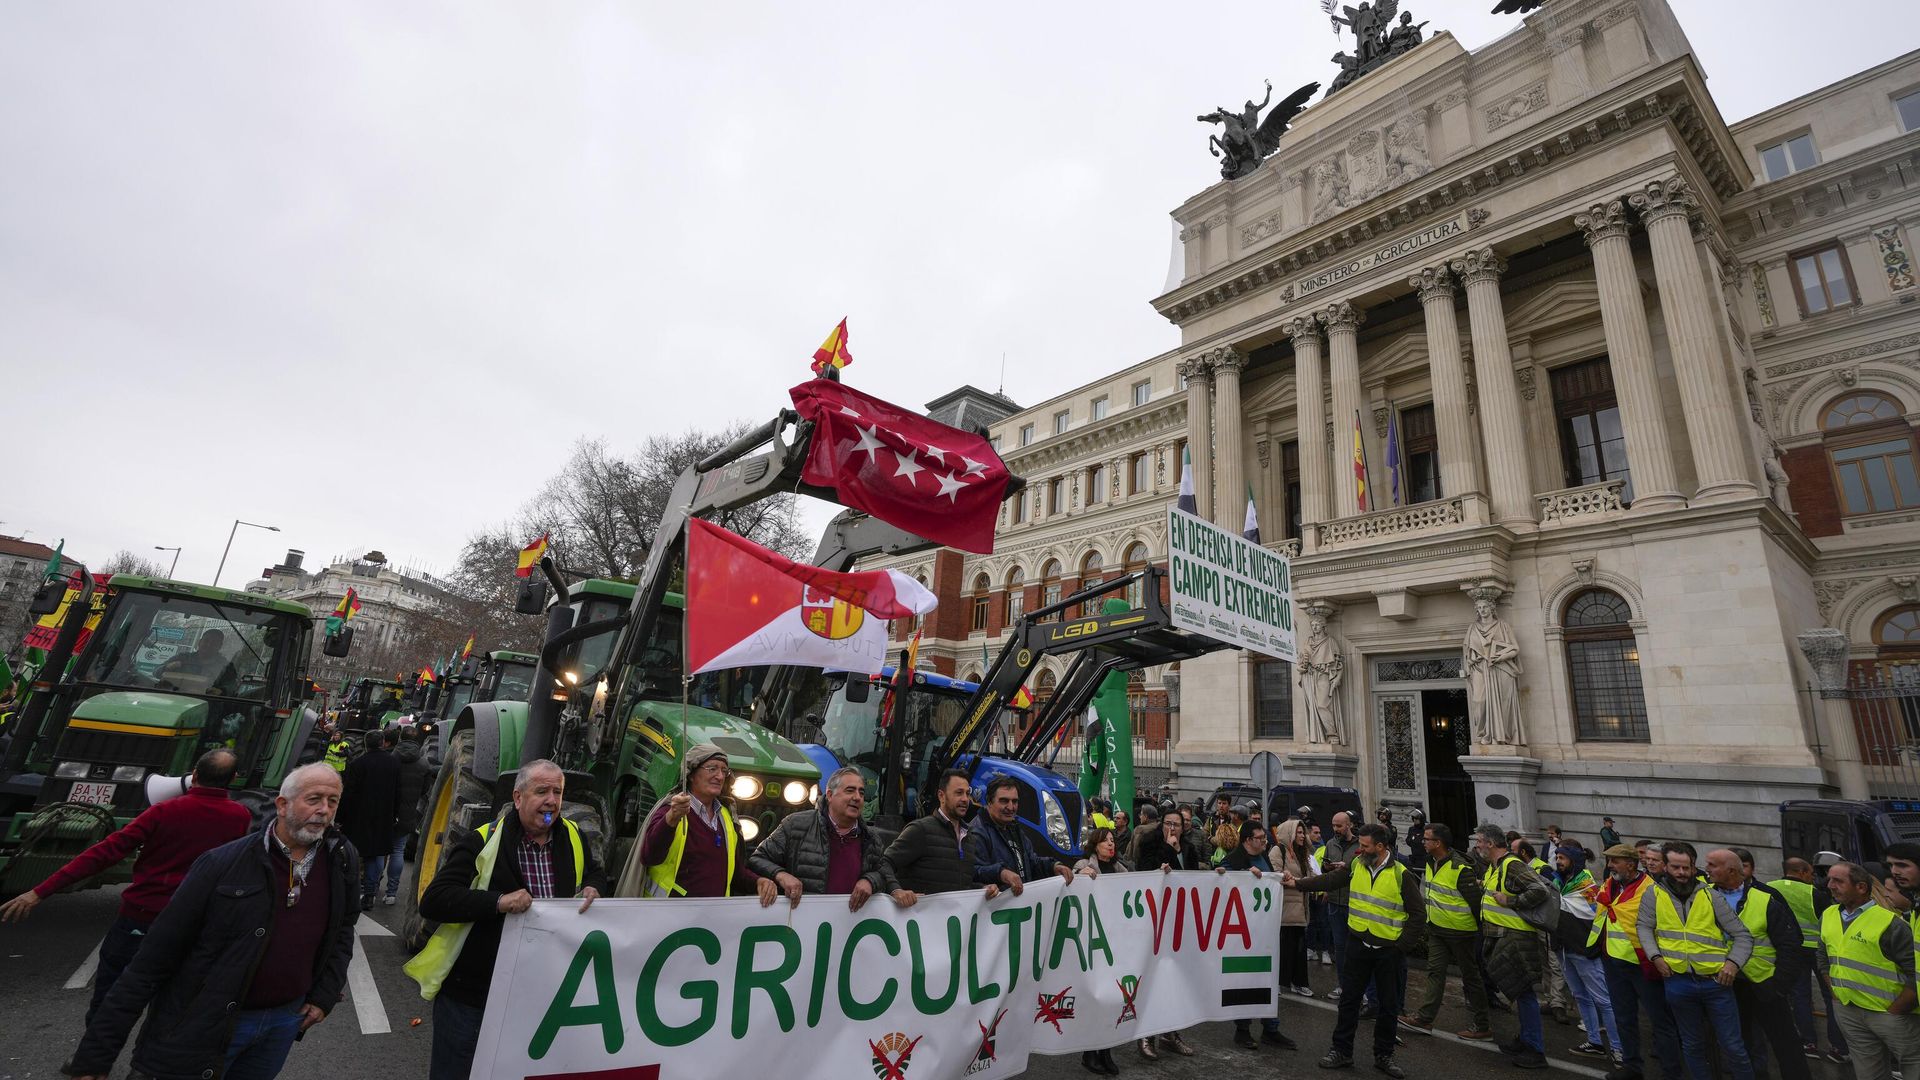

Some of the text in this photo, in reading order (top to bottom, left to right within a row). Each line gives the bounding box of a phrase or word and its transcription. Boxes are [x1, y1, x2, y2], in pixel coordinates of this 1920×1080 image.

[1300, 221, 1462, 295] MINISTERIO DE AGRICULTURA
[1171, 512, 1289, 595] EN DEFENSA DE NUESTRO
[1172, 555, 1220, 607] CAMPO
[1224, 575, 1292, 632] EXTREMEÑO
[74, 783, 112, 797] BA-VE
[1105, 718, 1122, 816] ASAJA
[528, 893, 1114, 1060] AGRICULTURA
